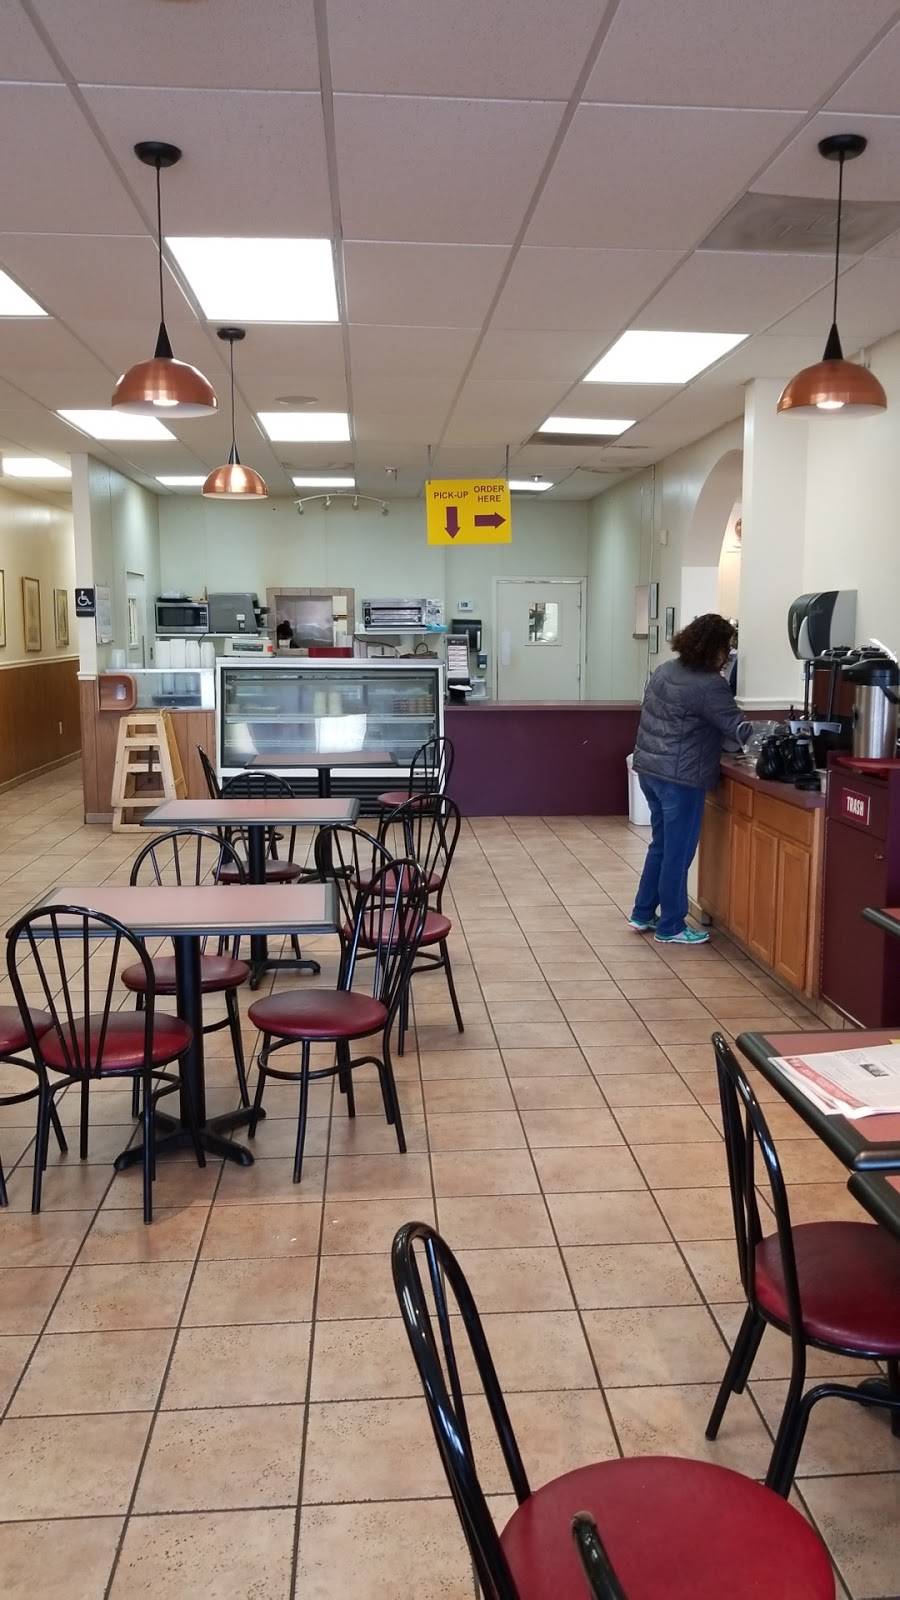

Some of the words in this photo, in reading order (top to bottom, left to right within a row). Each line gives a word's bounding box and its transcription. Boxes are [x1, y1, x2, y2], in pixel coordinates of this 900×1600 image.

[473, 485, 505, 493] ORDER
[433, 491, 469, 500] PICK-UP
[477, 495, 501, 503] HERE
[846, 796, 865, 817] TRASH
